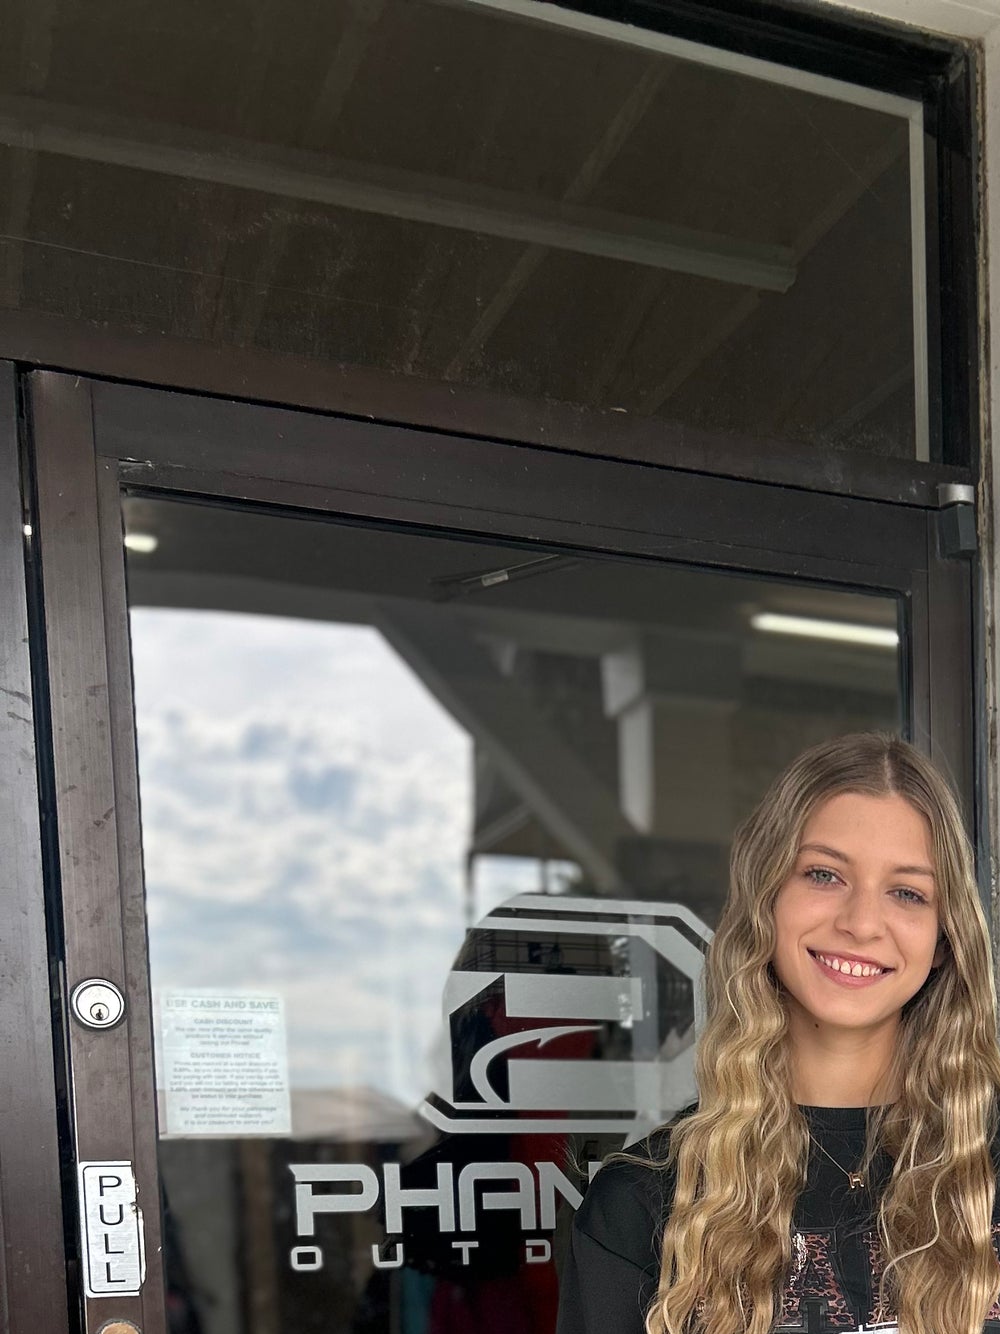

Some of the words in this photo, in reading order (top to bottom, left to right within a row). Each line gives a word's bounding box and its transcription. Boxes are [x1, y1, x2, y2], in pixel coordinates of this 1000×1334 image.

[191, 1000, 220, 1008] CASH
[224, 1000, 246, 1009] AND
[98, 1174, 127, 1283] PULL
